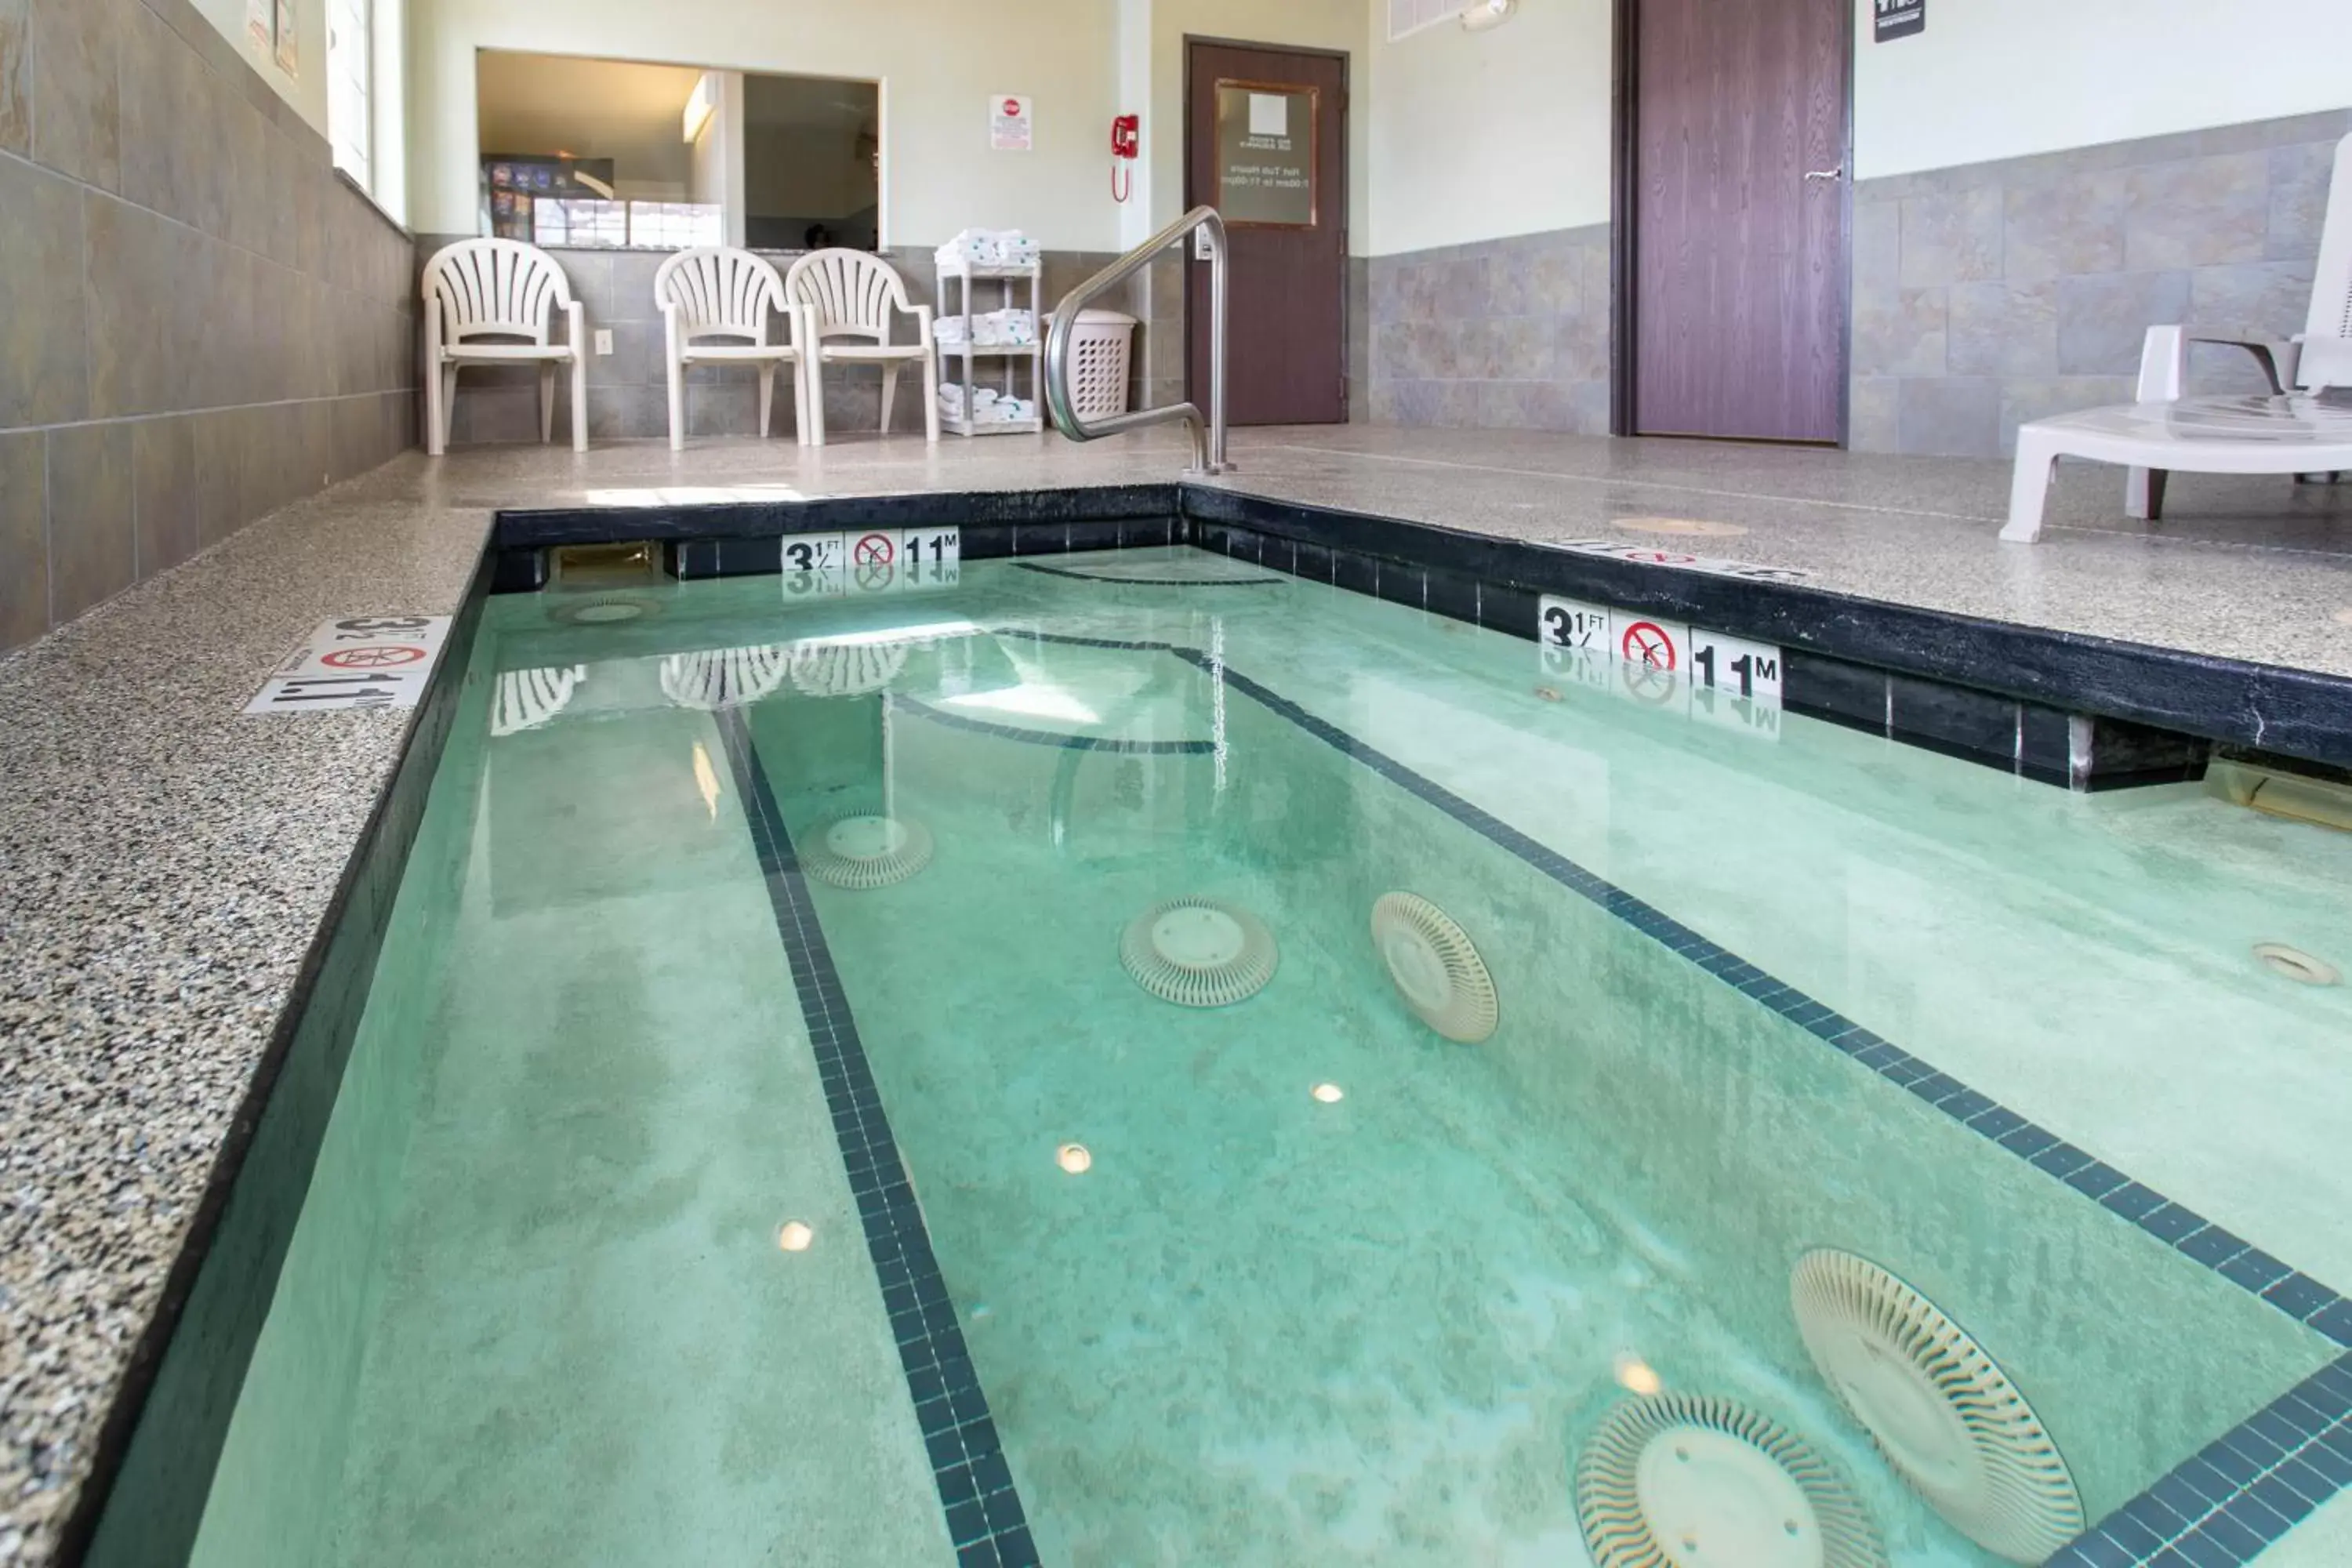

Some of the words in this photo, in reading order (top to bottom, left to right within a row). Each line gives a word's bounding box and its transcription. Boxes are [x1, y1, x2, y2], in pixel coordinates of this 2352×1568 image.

[827, 541, 840, 550] FT
[945, 534, 956, 546] M
[1589, 614, 1604, 630] FT
[1755, 656, 1776, 681] M
